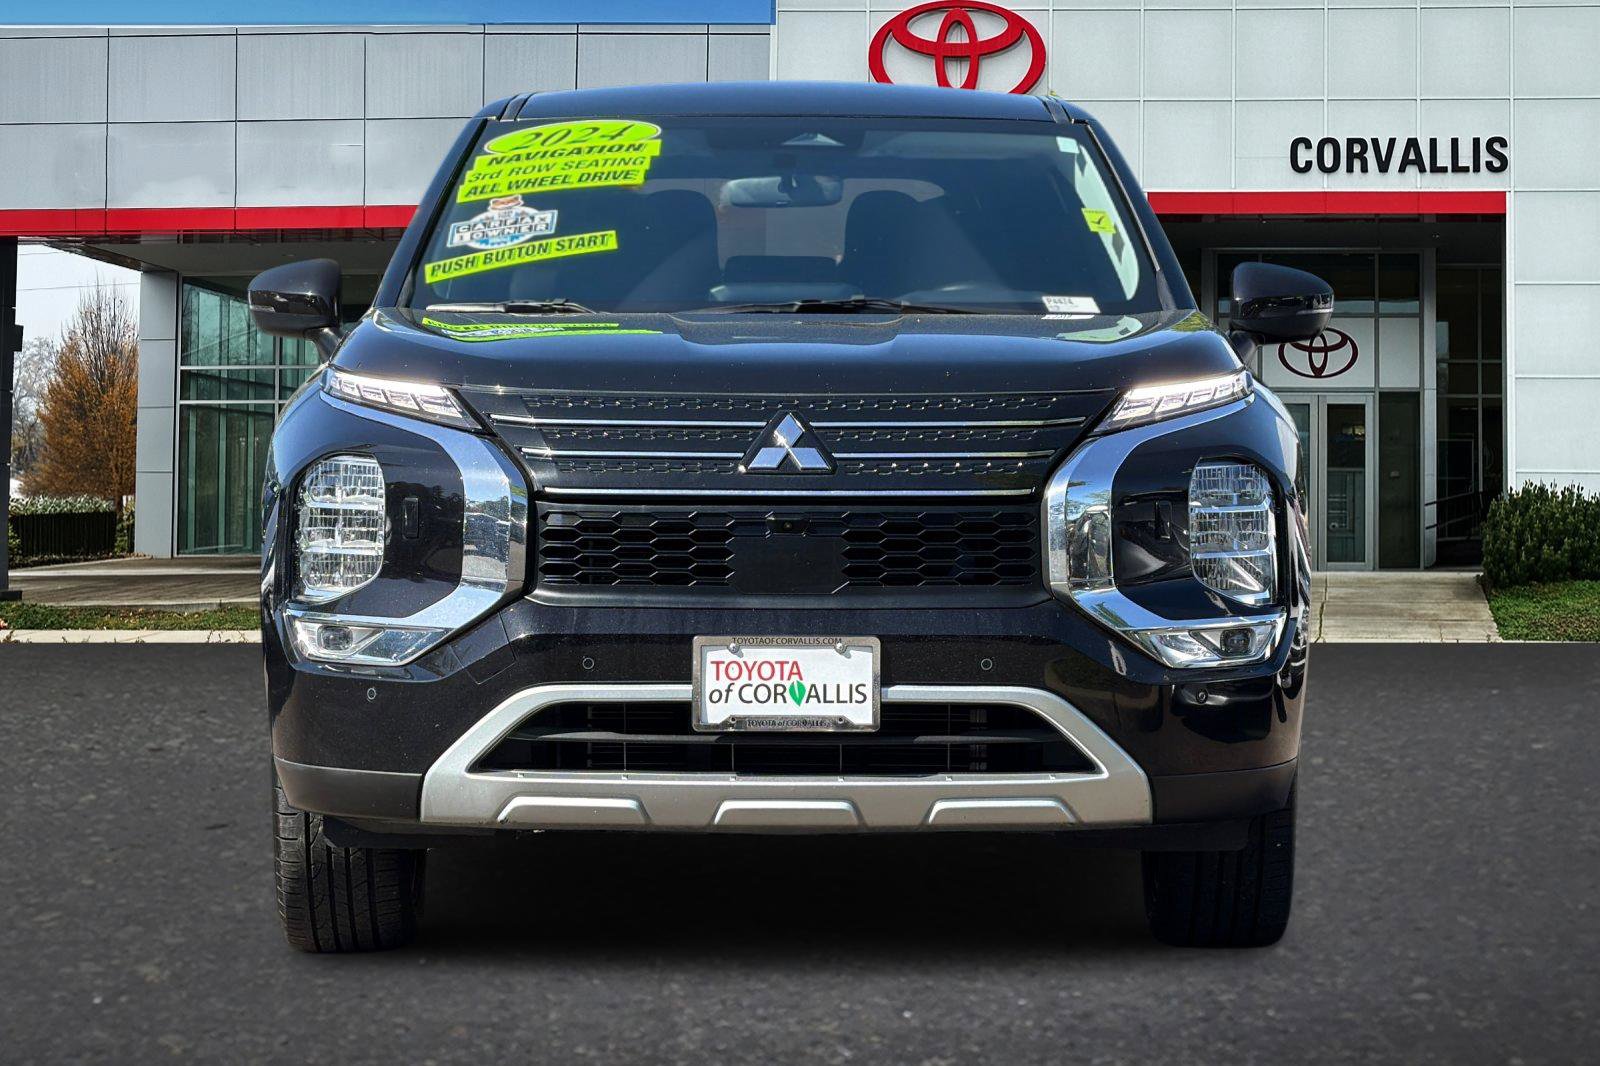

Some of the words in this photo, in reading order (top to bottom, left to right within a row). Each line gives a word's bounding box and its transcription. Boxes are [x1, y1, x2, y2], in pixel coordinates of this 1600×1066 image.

[508, 123, 635, 151] 2024
[468, 170, 502, 183] 3rd
[507, 162, 556, 178] ROW
[560, 155, 646, 171] SEATING
[487, 143, 646, 167] NAVIGATION
[1289, 136, 1509, 174] CORVALLIS
[464, 183, 502, 198] ALL
[506, 176, 574, 191] WHEEL
[577, 168, 639, 184] DRIVE
[430, 256, 480, 277] PUSH
[482, 241, 550, 267] BUTTON
[555, 233, 611, 252] START
[731, 637, 843, 645] TOYOTAOFCORVALLIS.COM
[710, 660, 804, 682] TOYOTA
[708, 682, 735, 704] of
